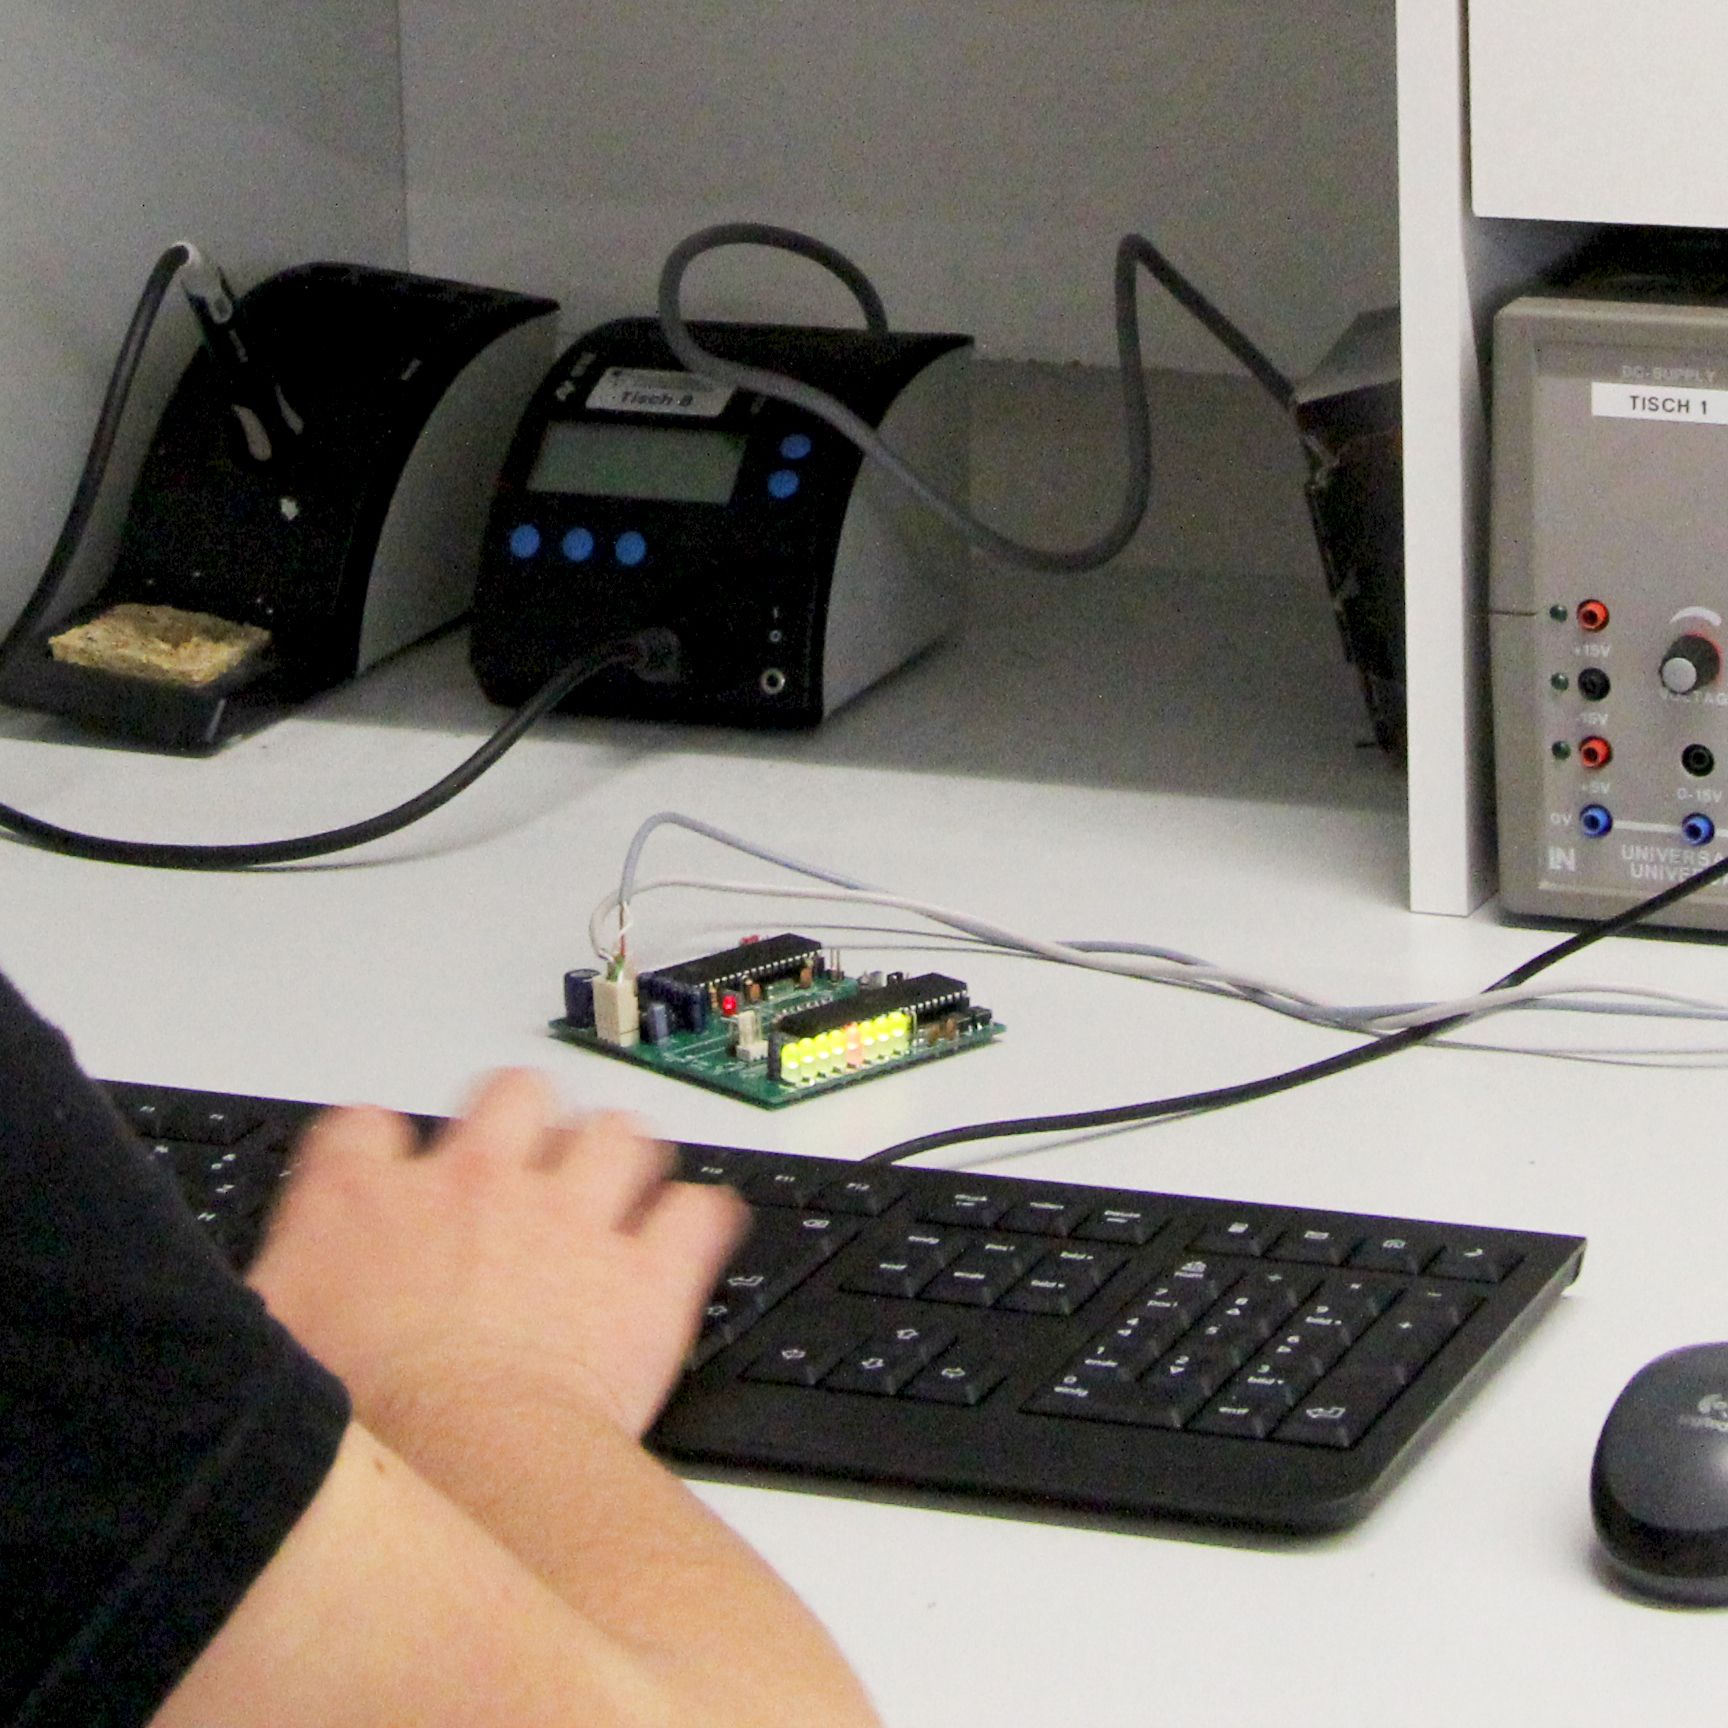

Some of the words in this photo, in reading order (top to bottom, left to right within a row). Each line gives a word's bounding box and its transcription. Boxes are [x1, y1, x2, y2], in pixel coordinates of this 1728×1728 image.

[620, 390, 674, 406] Tisch
[1630, 395, 1690, 414] TISCH
[1701, 400, 1708, 415] 1
[1622, 843, 1728, 868] UNIVERSA
